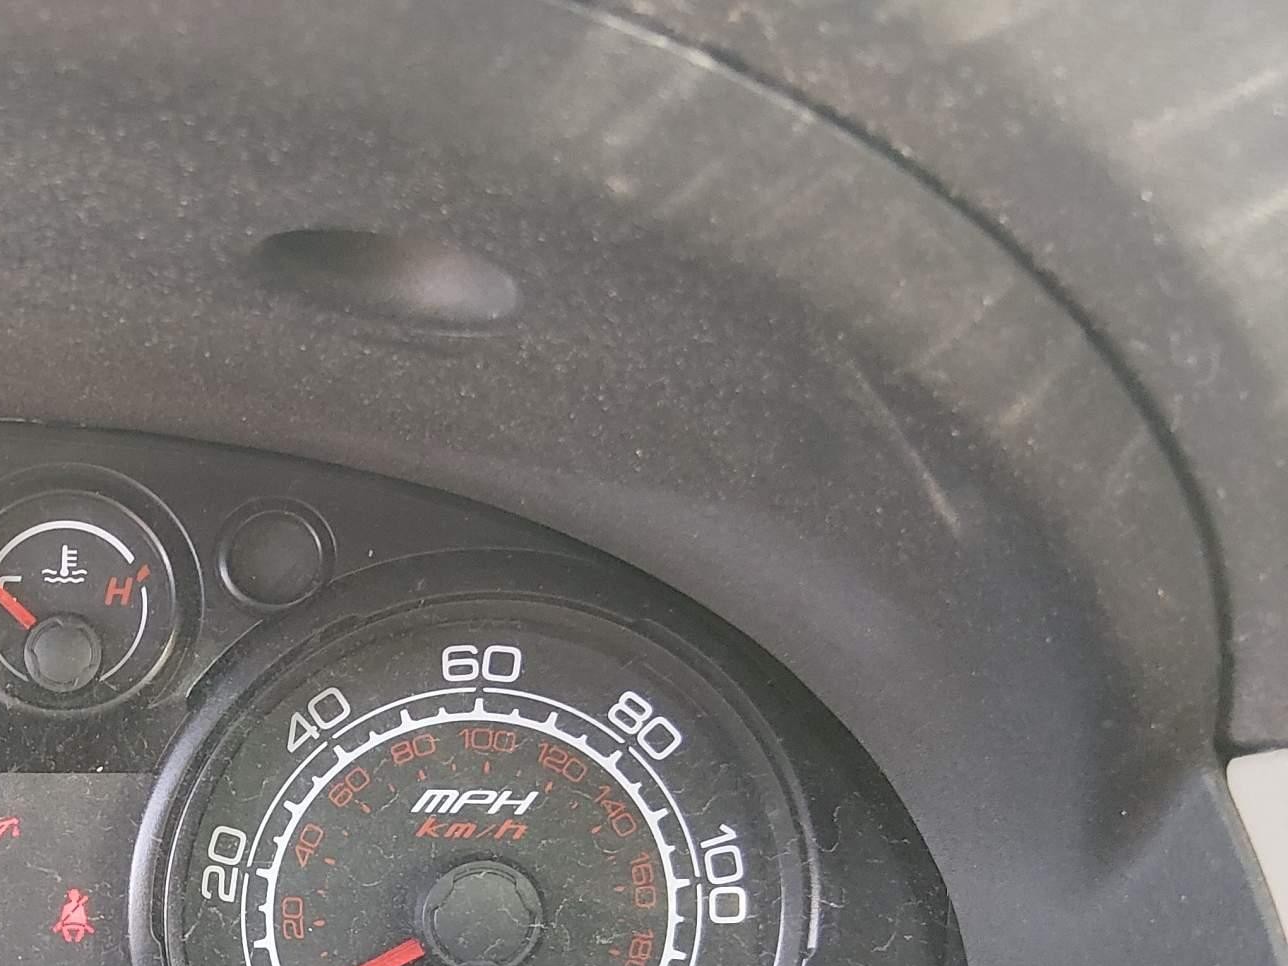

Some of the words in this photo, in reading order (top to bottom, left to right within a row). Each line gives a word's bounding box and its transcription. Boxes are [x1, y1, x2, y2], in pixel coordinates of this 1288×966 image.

[103, 576, 134, 606] H
[441, 644, 522, 683] 60
[287, 687, 351, 753] 40
[458, 728, 516, 753] 100
[608, 690, 682, 760] 80
[390, 733, 437, 765] 80
[538, 740, 588, 783] 120
[328, 766, 371, 807] 60
[411, 788, 539, 816] MPH
[415, 816, 529, 841] km/h
[594, 785, 637, 837] 140
[201, 825, 247, 902] 20
[296, 823, 324, 868] 40
[631, 852, 657, 909] 160
[700, 823, 747, 924] 100
[282, 896, 305, 940] 20
